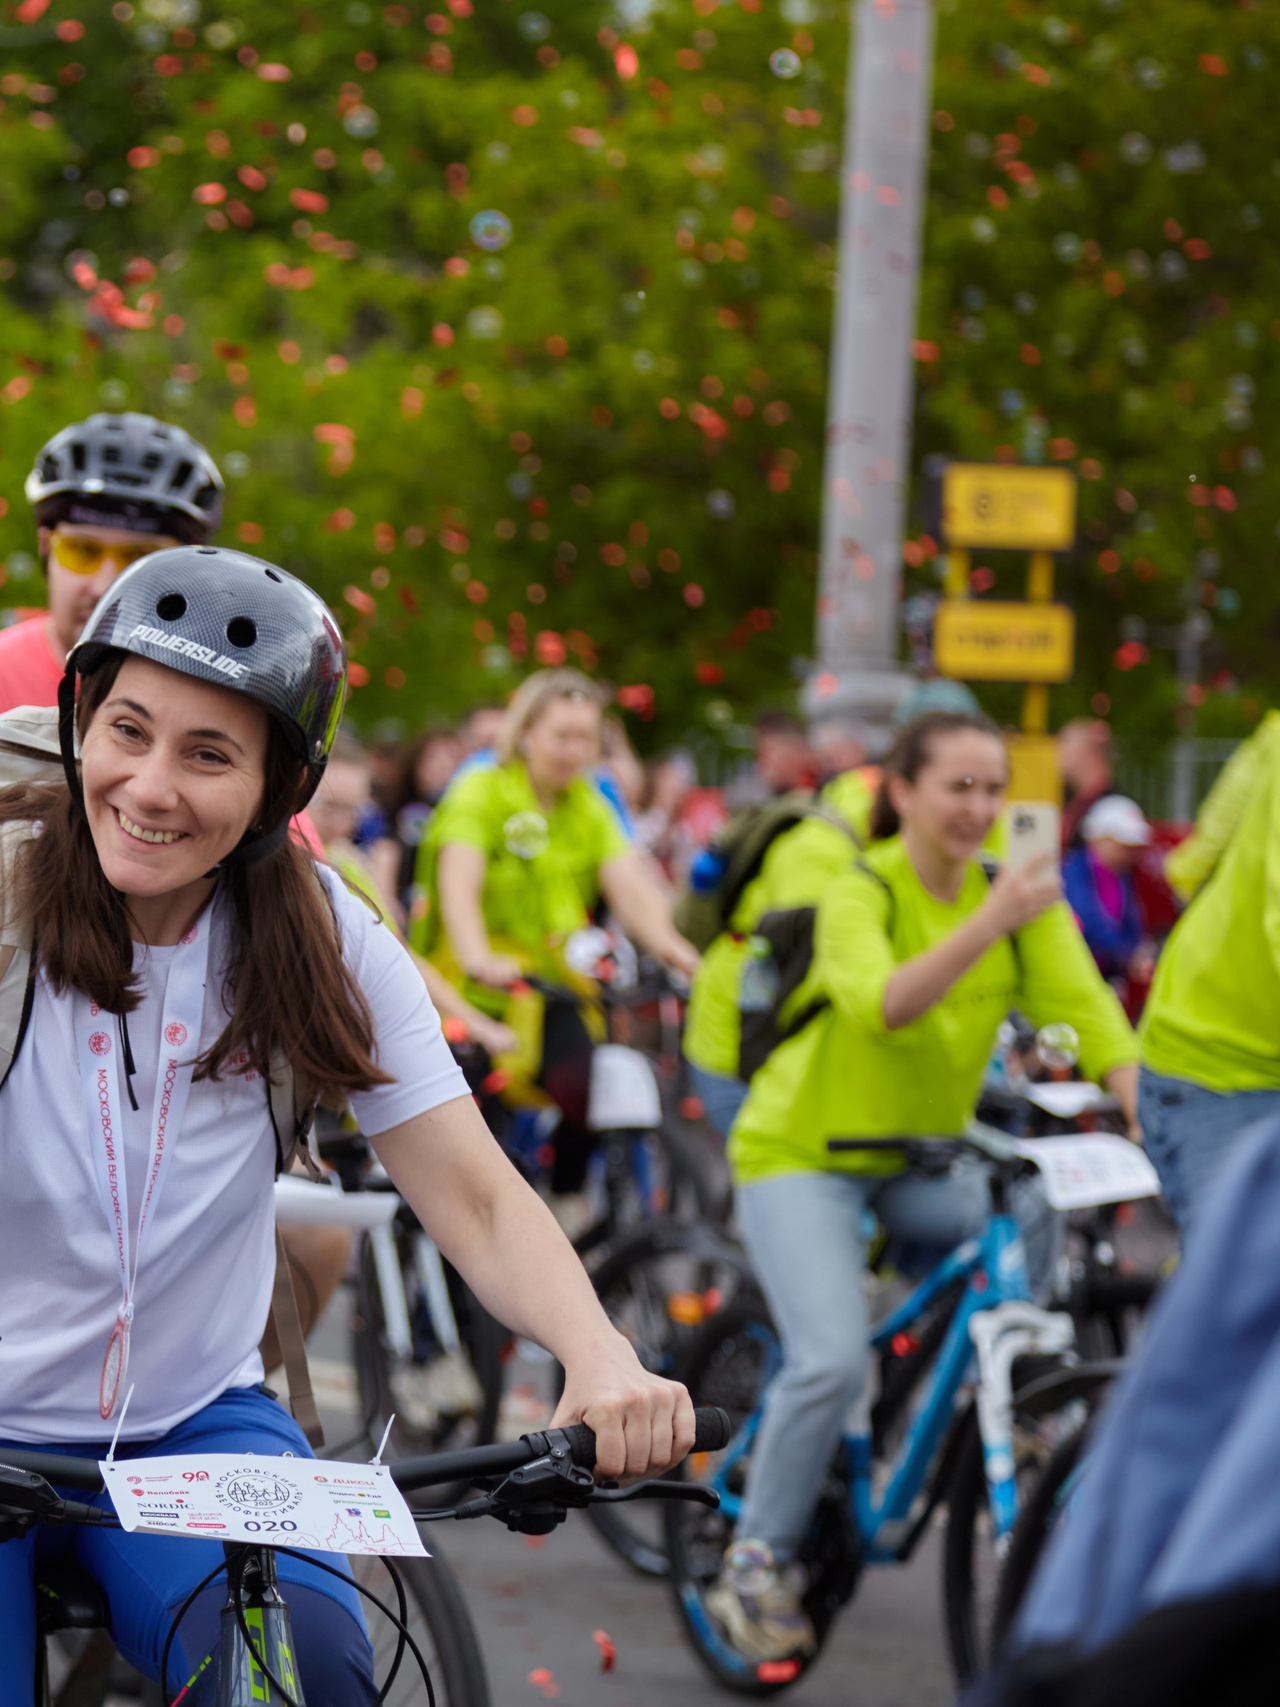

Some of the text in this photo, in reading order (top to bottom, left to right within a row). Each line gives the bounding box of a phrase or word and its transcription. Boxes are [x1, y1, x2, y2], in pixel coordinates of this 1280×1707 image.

[130, 624, 250, 679] POWERSLIDE
[97, 1068, 117, 1161] МОСКОВСКИЙ
[157, 1058, 178, 1150] МОСКОВСКИЙ
[214, 1468, 298, 1489] МОСКОВСКИЙ
[136, 1502, 195, 1510] NORDIC
[215, 1491, 303, 1518] ВЕЛОФЕСТИВАЛЬ
[244, 1520, 298, 1532] 020
